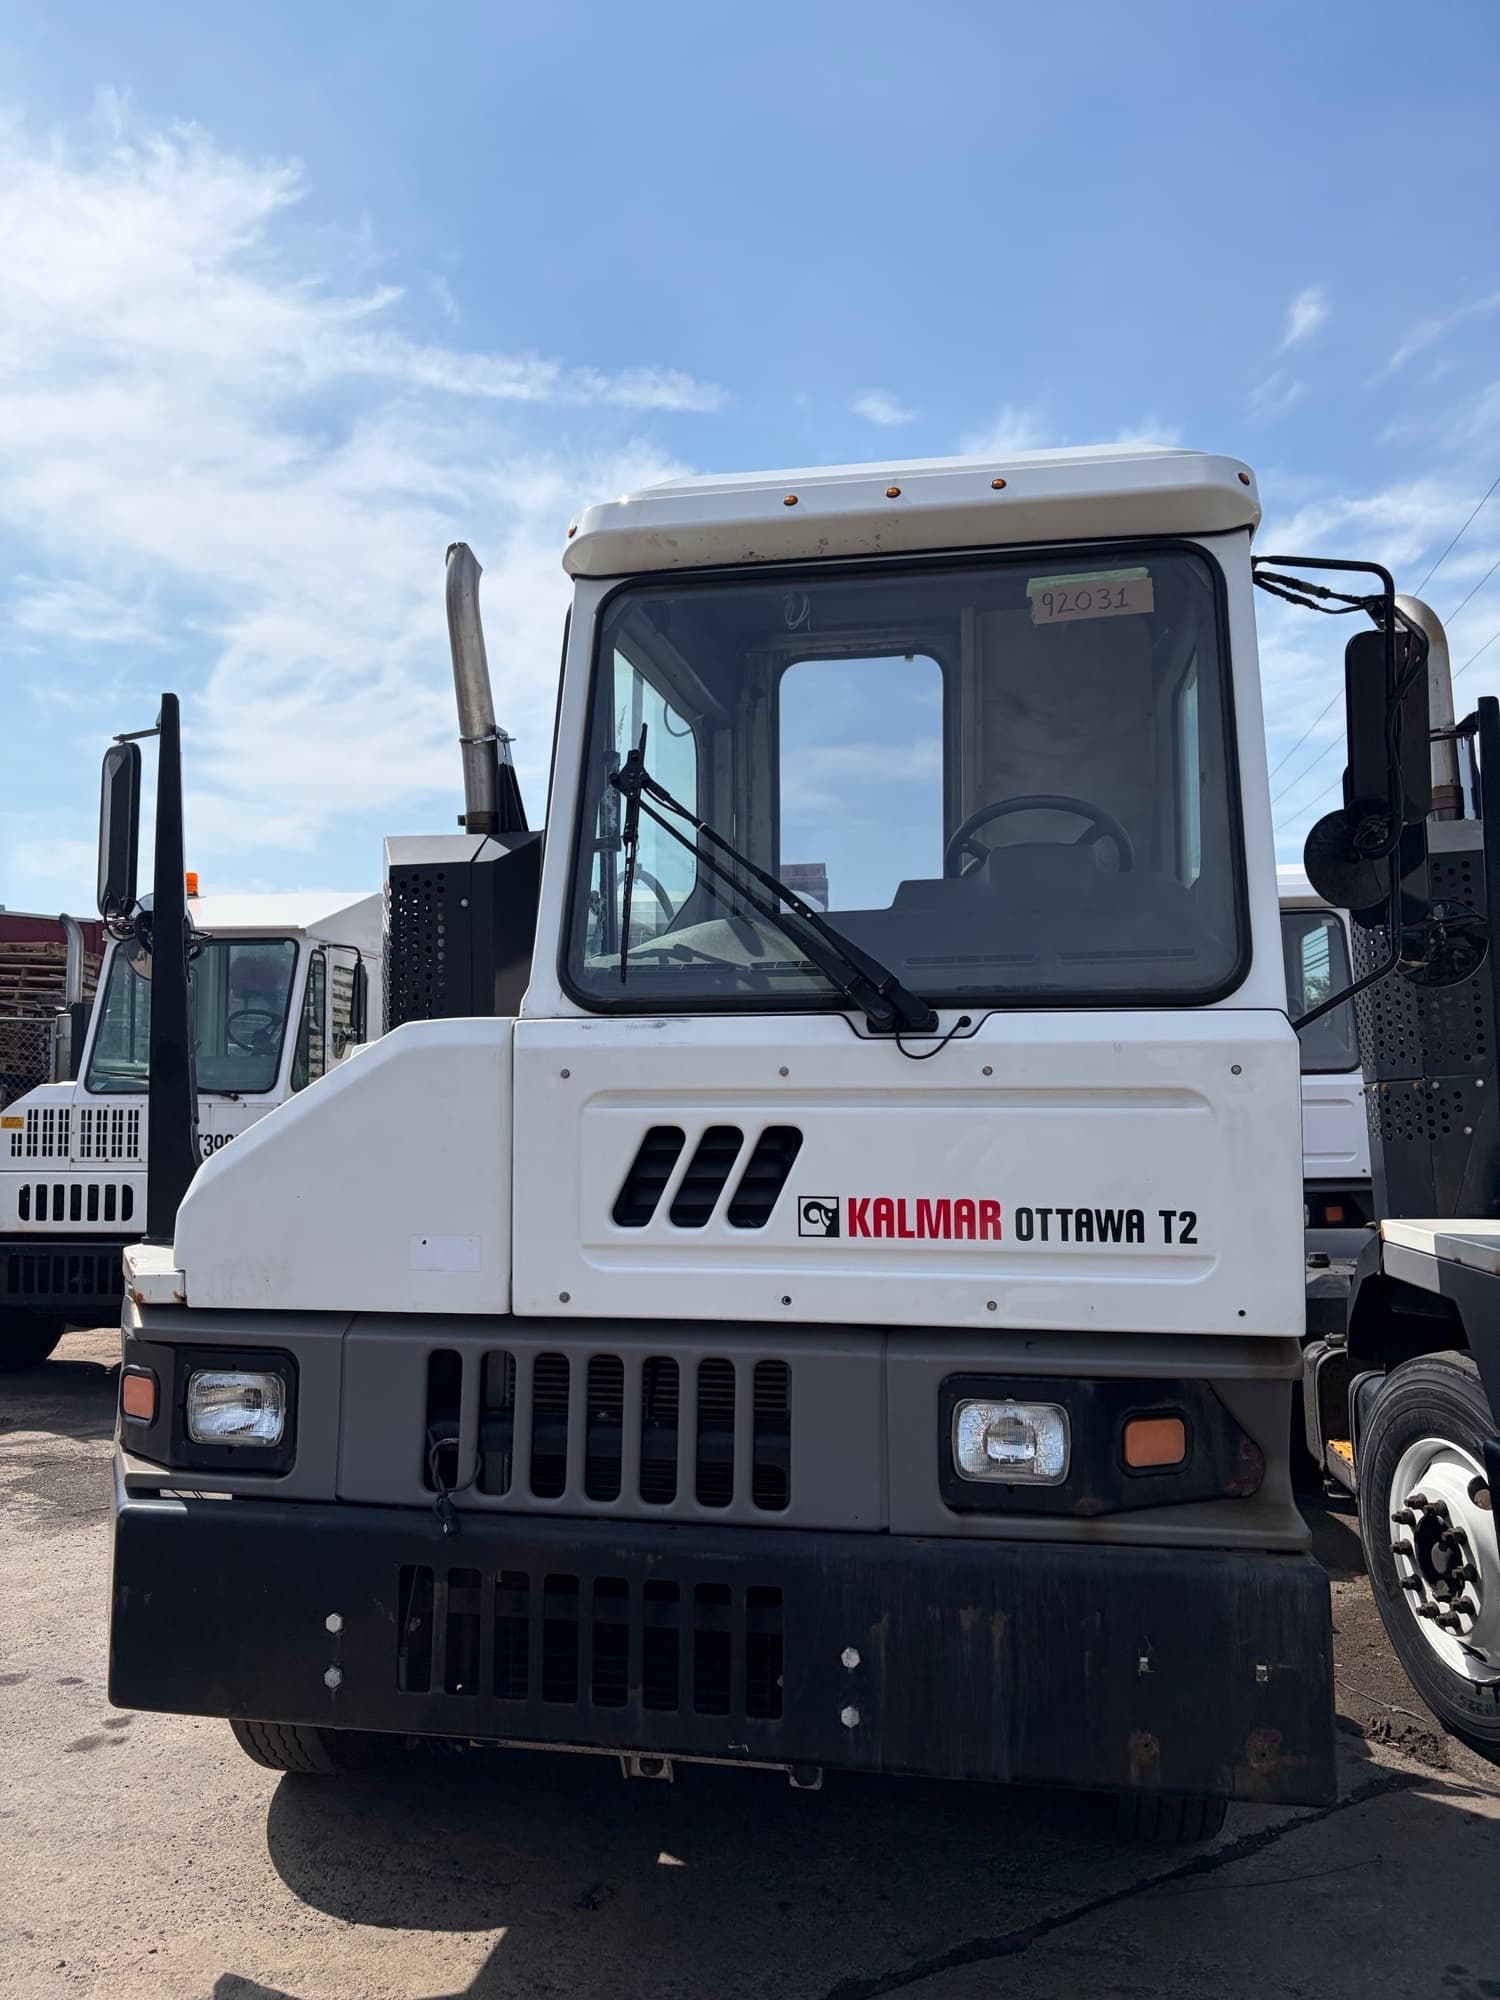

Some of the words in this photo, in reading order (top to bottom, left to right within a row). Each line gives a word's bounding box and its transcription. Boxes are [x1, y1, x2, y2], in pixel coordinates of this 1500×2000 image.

[1041, 587, 1129, 617] 92031
[847, 1197, 1002, 1241] KALMAR
[1014, 1207, 1146, 1244] OTTAWA
[1158, 1209, 1198, 1245] T2
